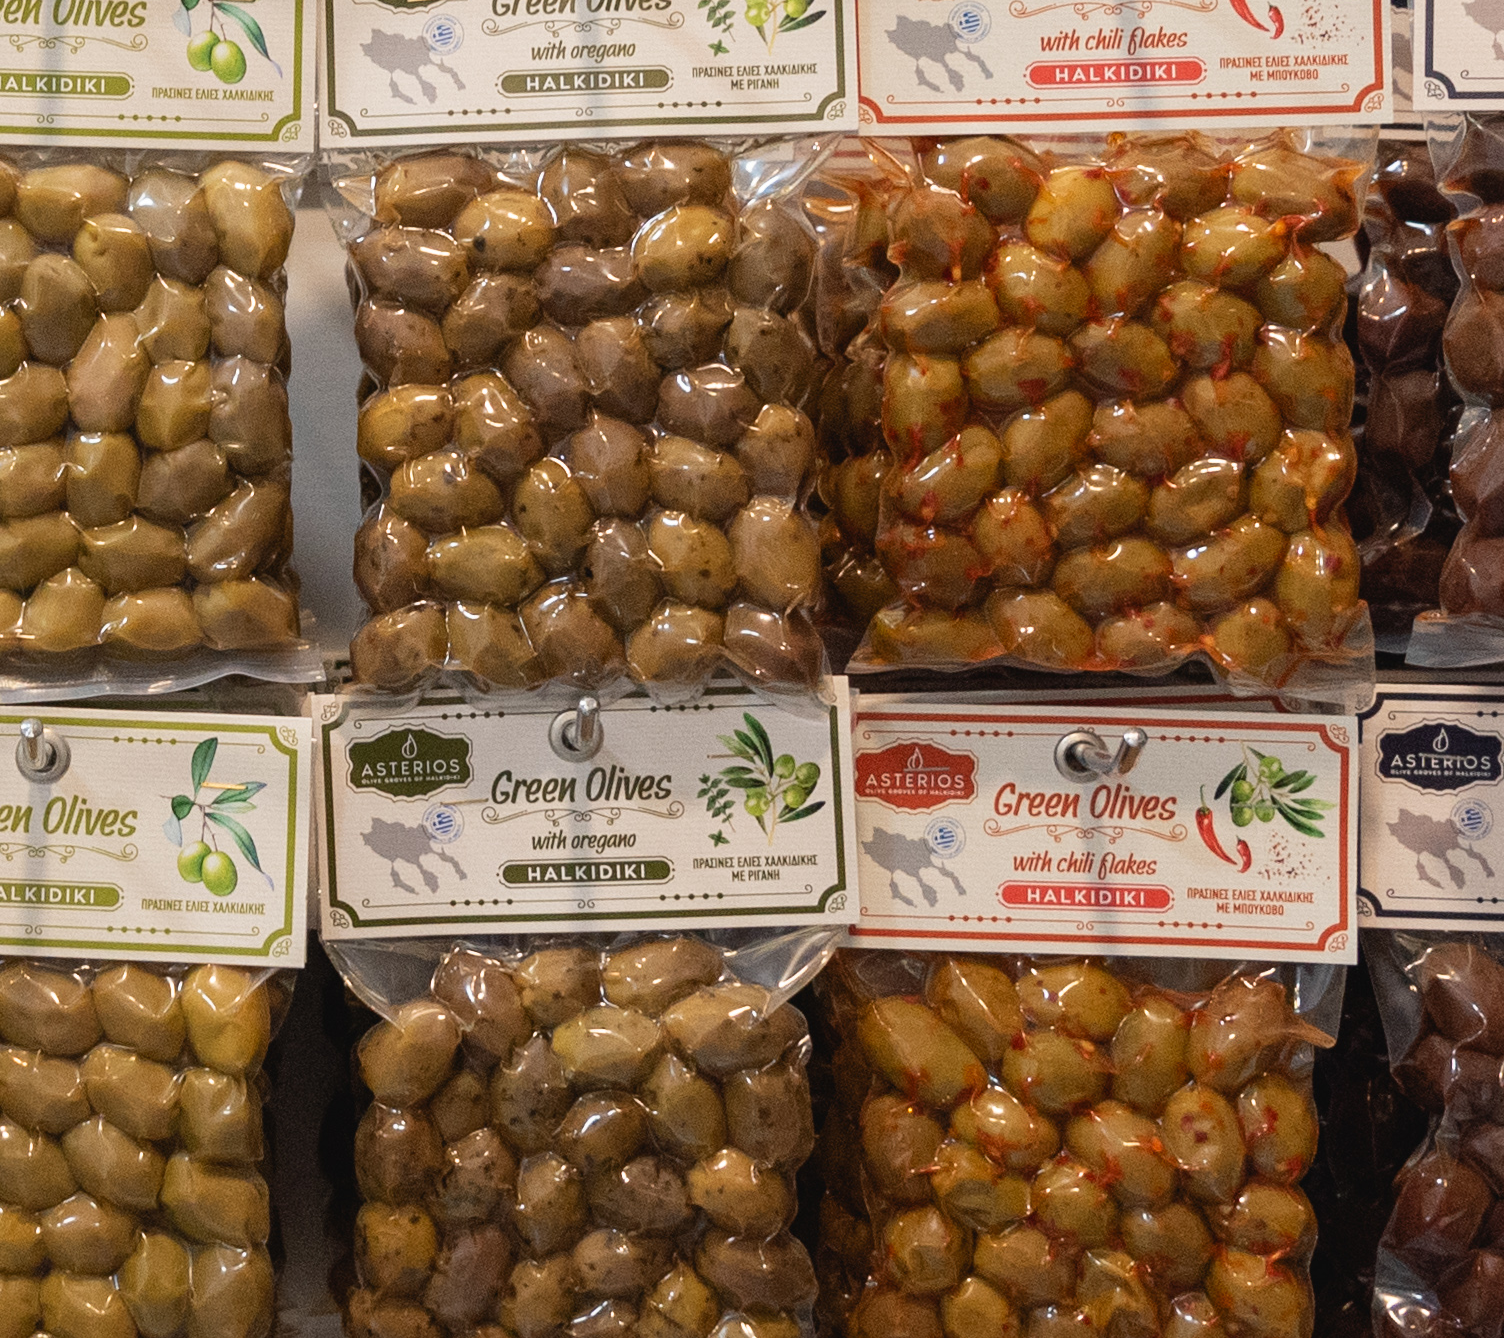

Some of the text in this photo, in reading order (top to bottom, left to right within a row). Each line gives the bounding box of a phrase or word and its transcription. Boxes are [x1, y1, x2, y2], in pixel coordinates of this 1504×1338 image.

[1041, 26, 1187, 56] with chili flakes
[532, 40, 635, 64] with oregano
[1220, 54, 1348, 68] ΠΡΑΣΙΝΕΣ ΕΛΙΕΣ ΧΑΛΚΙΔΙΚΗΣ
[692, 63, 817, 77] ΠΡΑΣΙΝΕΣ ΕΛΙΕΣ ΧΑΛΚΙΔΙΚΗΣ
[1056, 64, 1176, 82] HALKIDIKI
[1250, 69, 1318, 81] ΜΕ ΜΠΟΥΚΟΒΟ
[527, 73, 643, 91] HALKIDIKI
[731, 78, 779, 90] ΜΕ ΡΙΓΑΝΗ
[152, 87, 274, 102] ΠΡΑΣΙΝΕΣ ΕΛΙΕΣ ΧΑΛΚΙΔΙΚΗΣ
[361, 759, 460, 777] ASTERIOS
[1390, 753, 1491, 770] ASTERIOS
[491, 764, 671, 804] Green Olives
[865, 772, 965, 788] ASTERIOS
[994, 782, 1177, 820] Green Olives
[43, 795, 138, 837] Olives
[532, 830, 636, 854] with oregano
[693, 854, 818, 869] ΠΡΑΣΙΝΕΣ ΕΛΙΕΣ ΧΑΛΚΙΔΙΚΗΣ
[1014, 850, 1157, 880] with chili flakes
[528, 864, 645, 881] HALKIDIKI
[732, 869, 780, 881] ΜΕ ΡΙΓΑΝΗ
[1028, 888, 1144, 905] HALKIDIKI
[1187, 888, 1314, 903] ΠΡΑΣΙΝΕΣ ΕΛΙΕΣ ΧΑΛΚΙΔΙΚΗΣ
[142, 898, 265, 915] ΠΡΑΣΙΝΕΣ ΕΛΙΕΣ ΧΑΛΚΙΔΙΚΗΣ
[1217, 902, 1284, 916] ΜΕ ΜΠΟΥΚΟΒΟ
